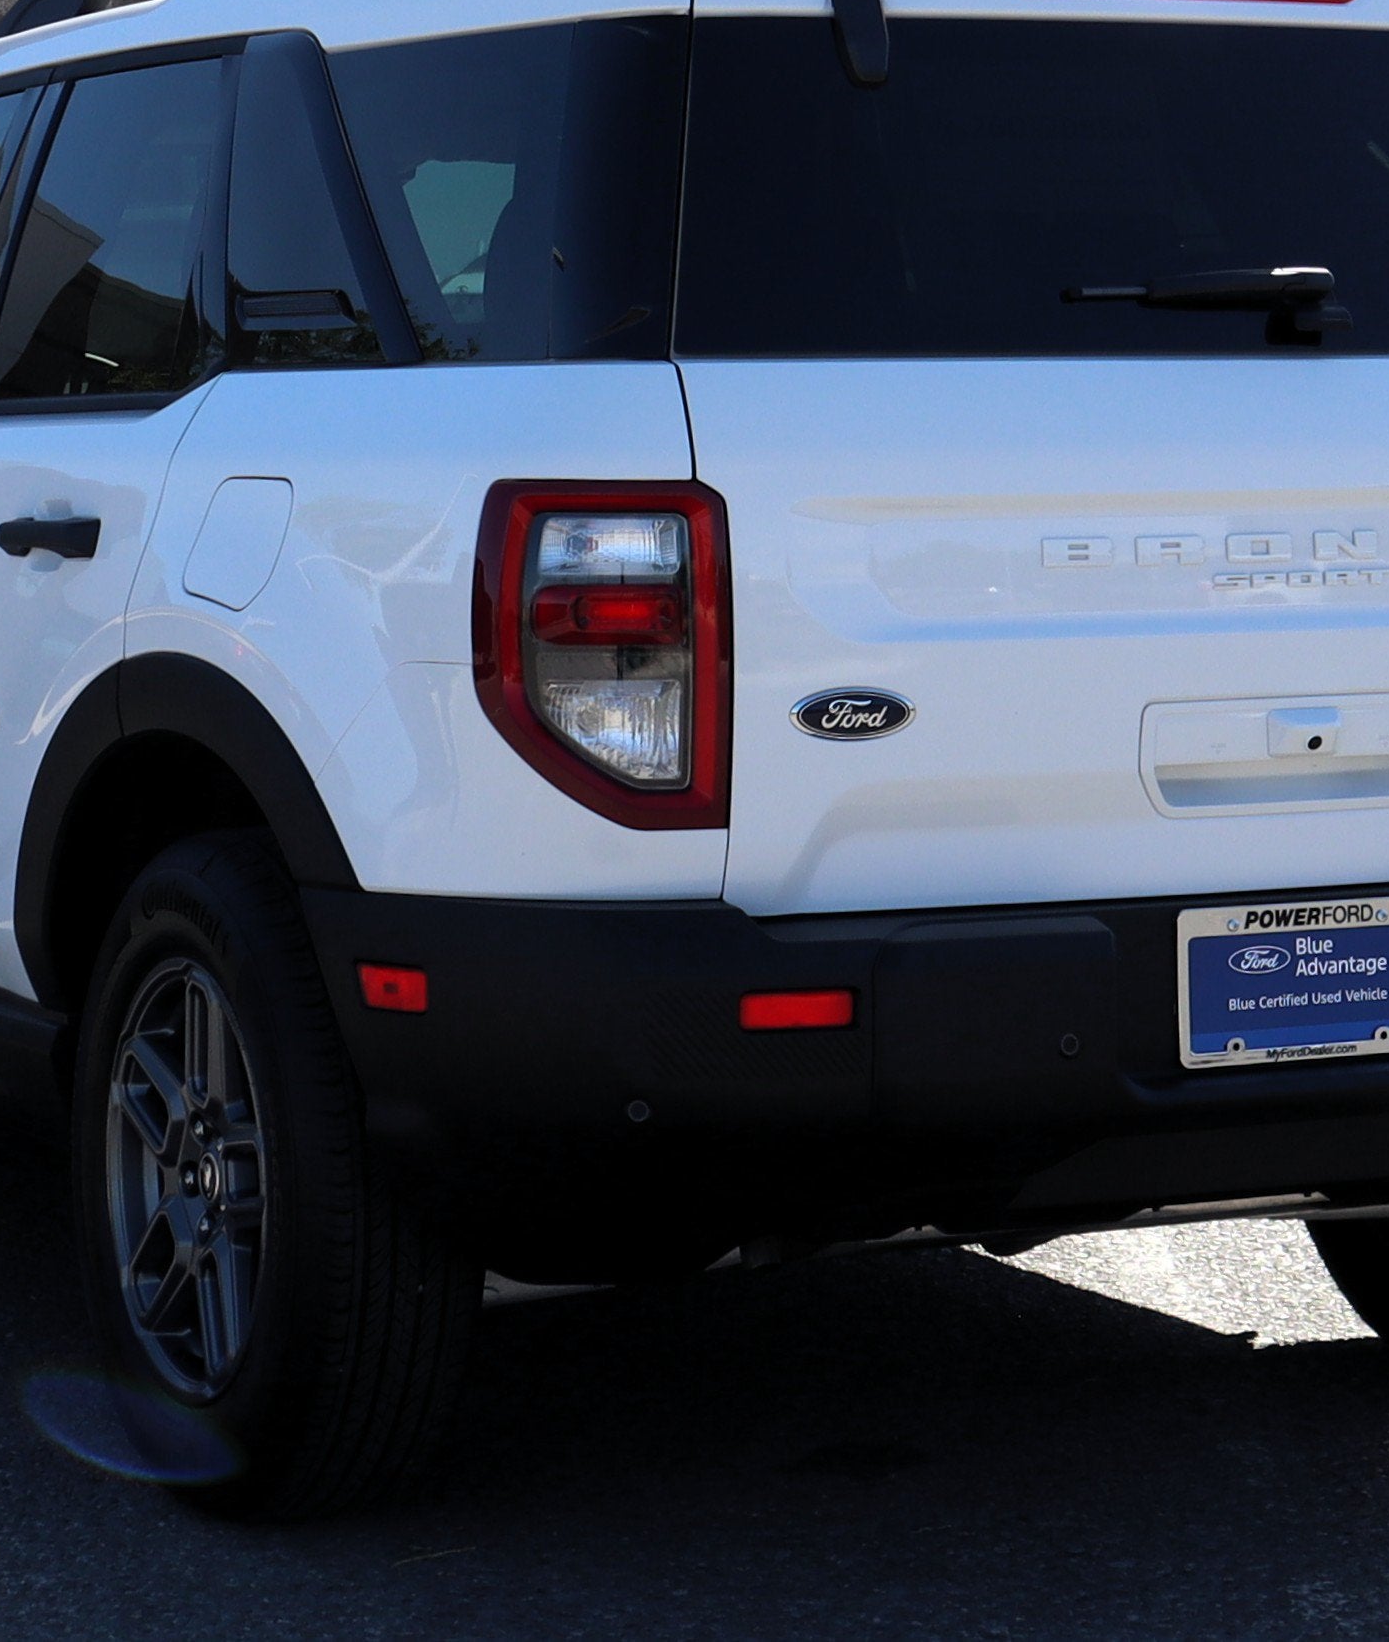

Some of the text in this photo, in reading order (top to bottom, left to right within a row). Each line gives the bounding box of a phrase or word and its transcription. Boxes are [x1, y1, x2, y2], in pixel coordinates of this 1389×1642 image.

[820, 699, 888, 728] Ford
[1296, 937, 1333, 955] Blue
[1240, 949, 1280, 970] Ford
[1295, 956, 1388, 977] Advantage
[1228, 987, 1388, 1011] Blue Certified Used Vehicle
[1265, 1043, 1358, 1062] MyFordDealer.com
